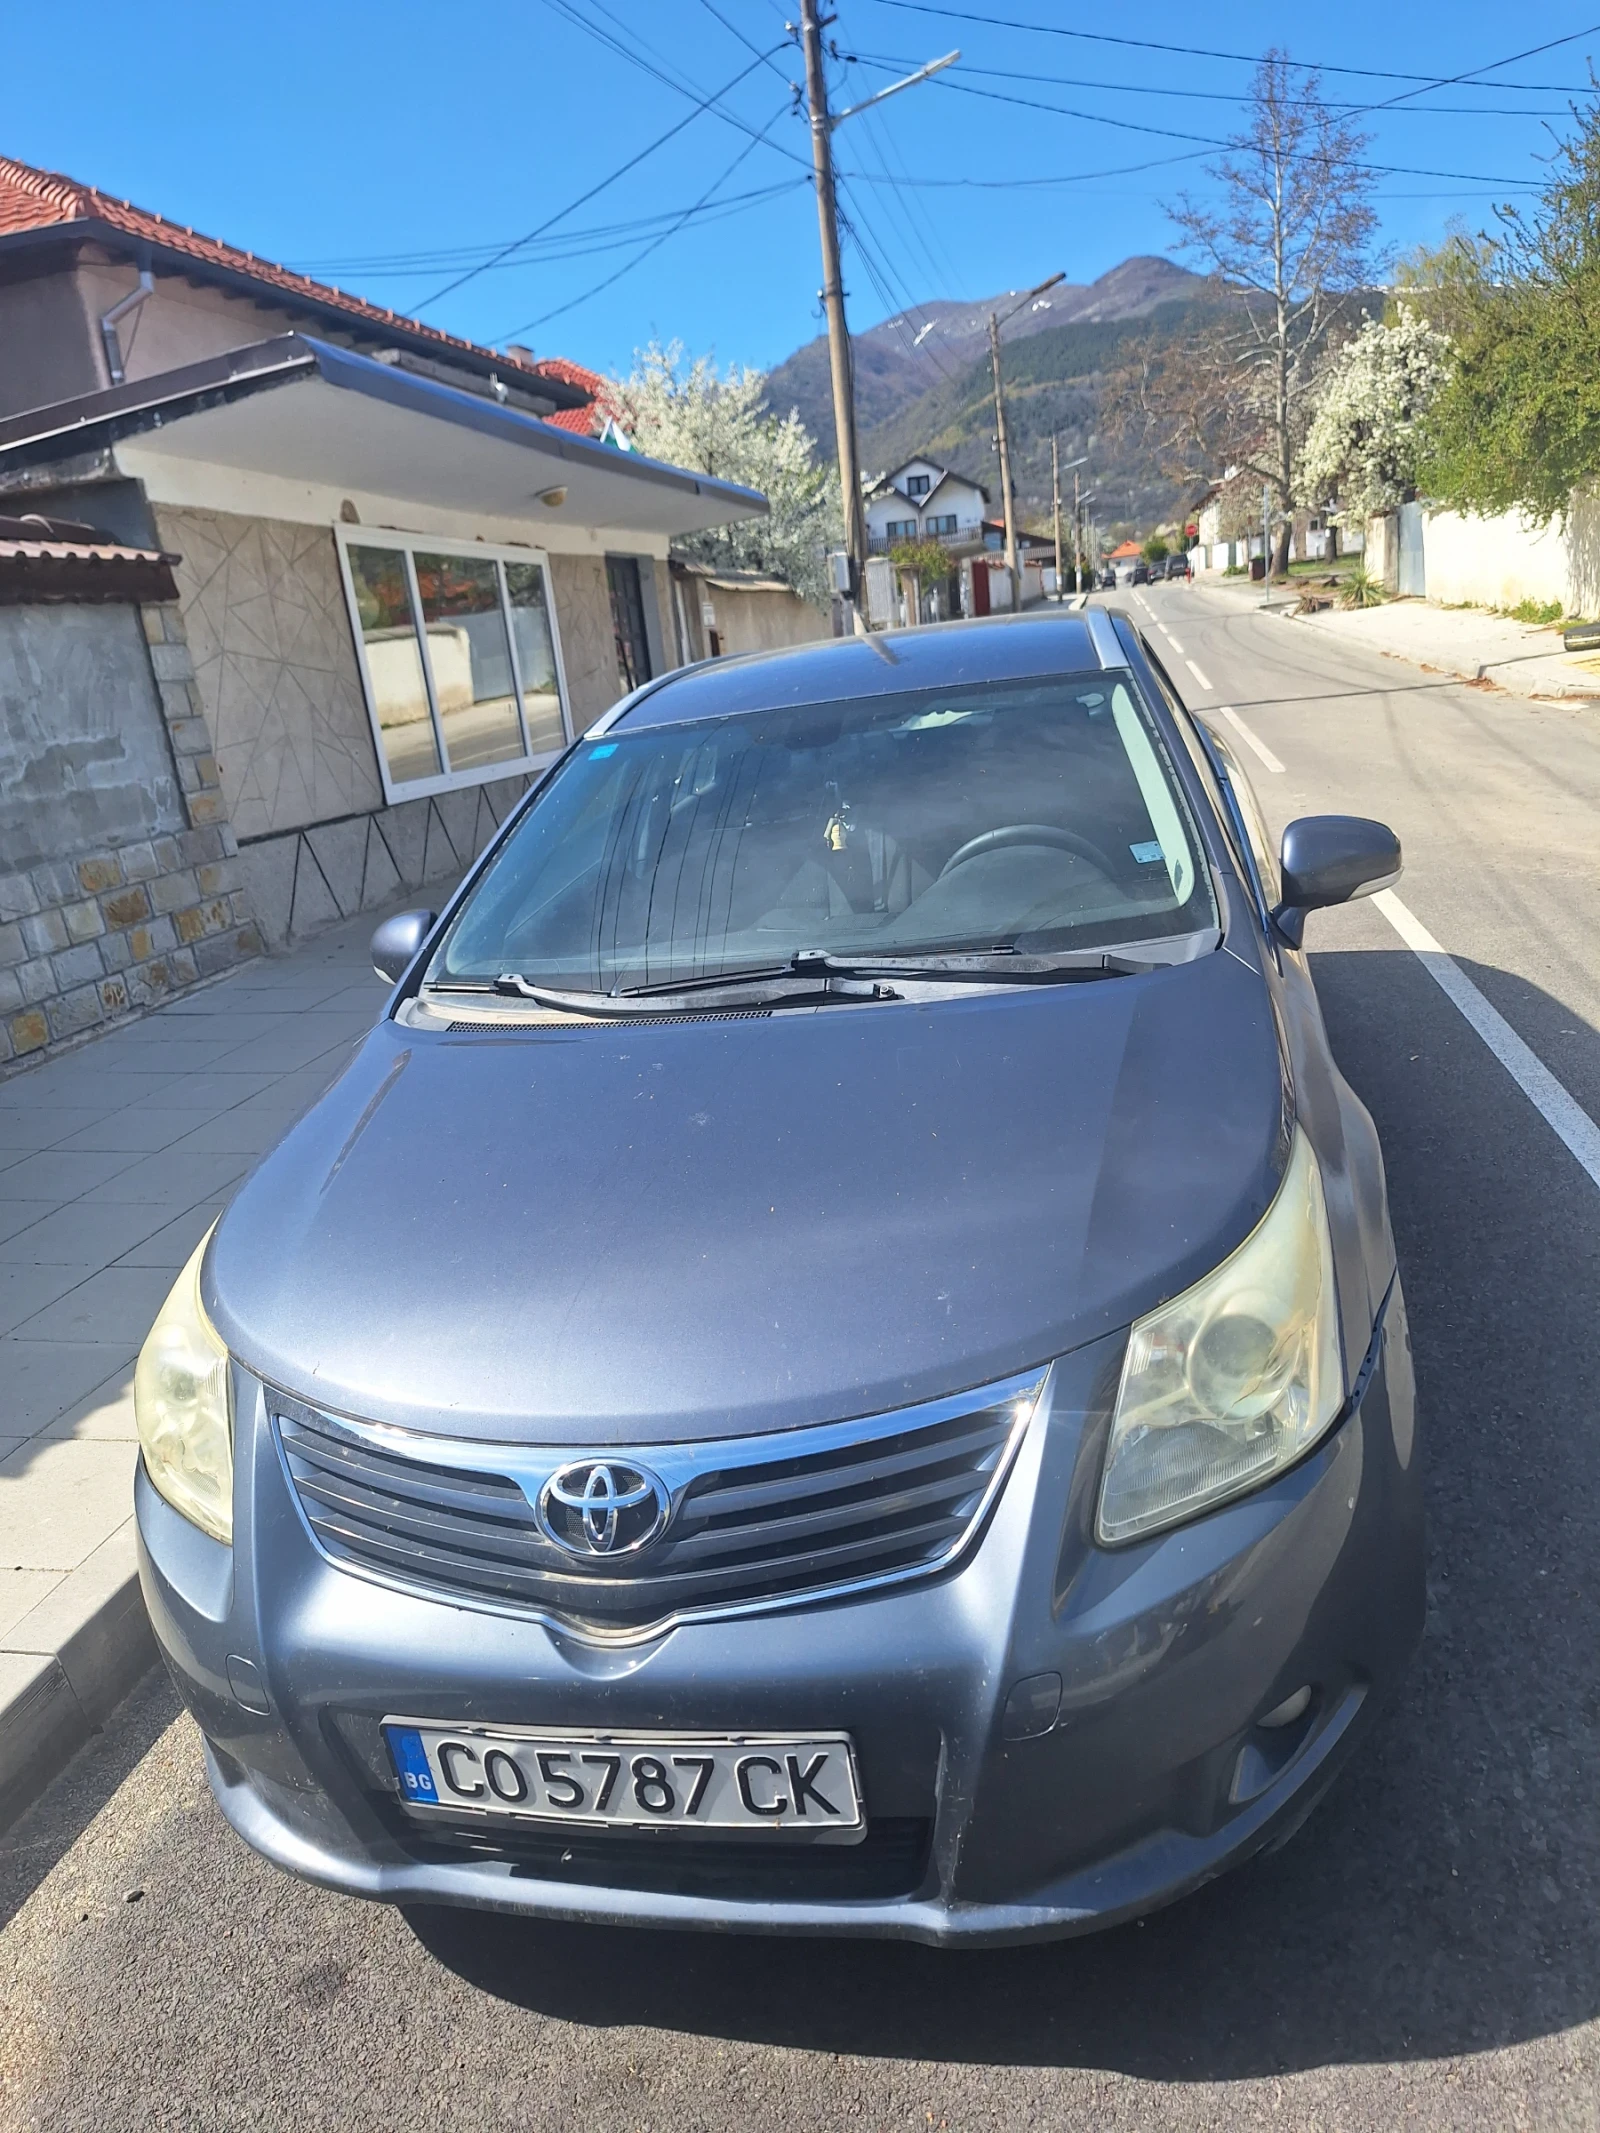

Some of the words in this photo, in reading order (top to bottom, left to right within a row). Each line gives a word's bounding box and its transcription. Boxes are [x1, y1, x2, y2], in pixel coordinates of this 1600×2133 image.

[403, 1771, 432, 1790] BG
[534, 1750, 715, 1816] 5787
[735, 1752, 841, 1816] CK
